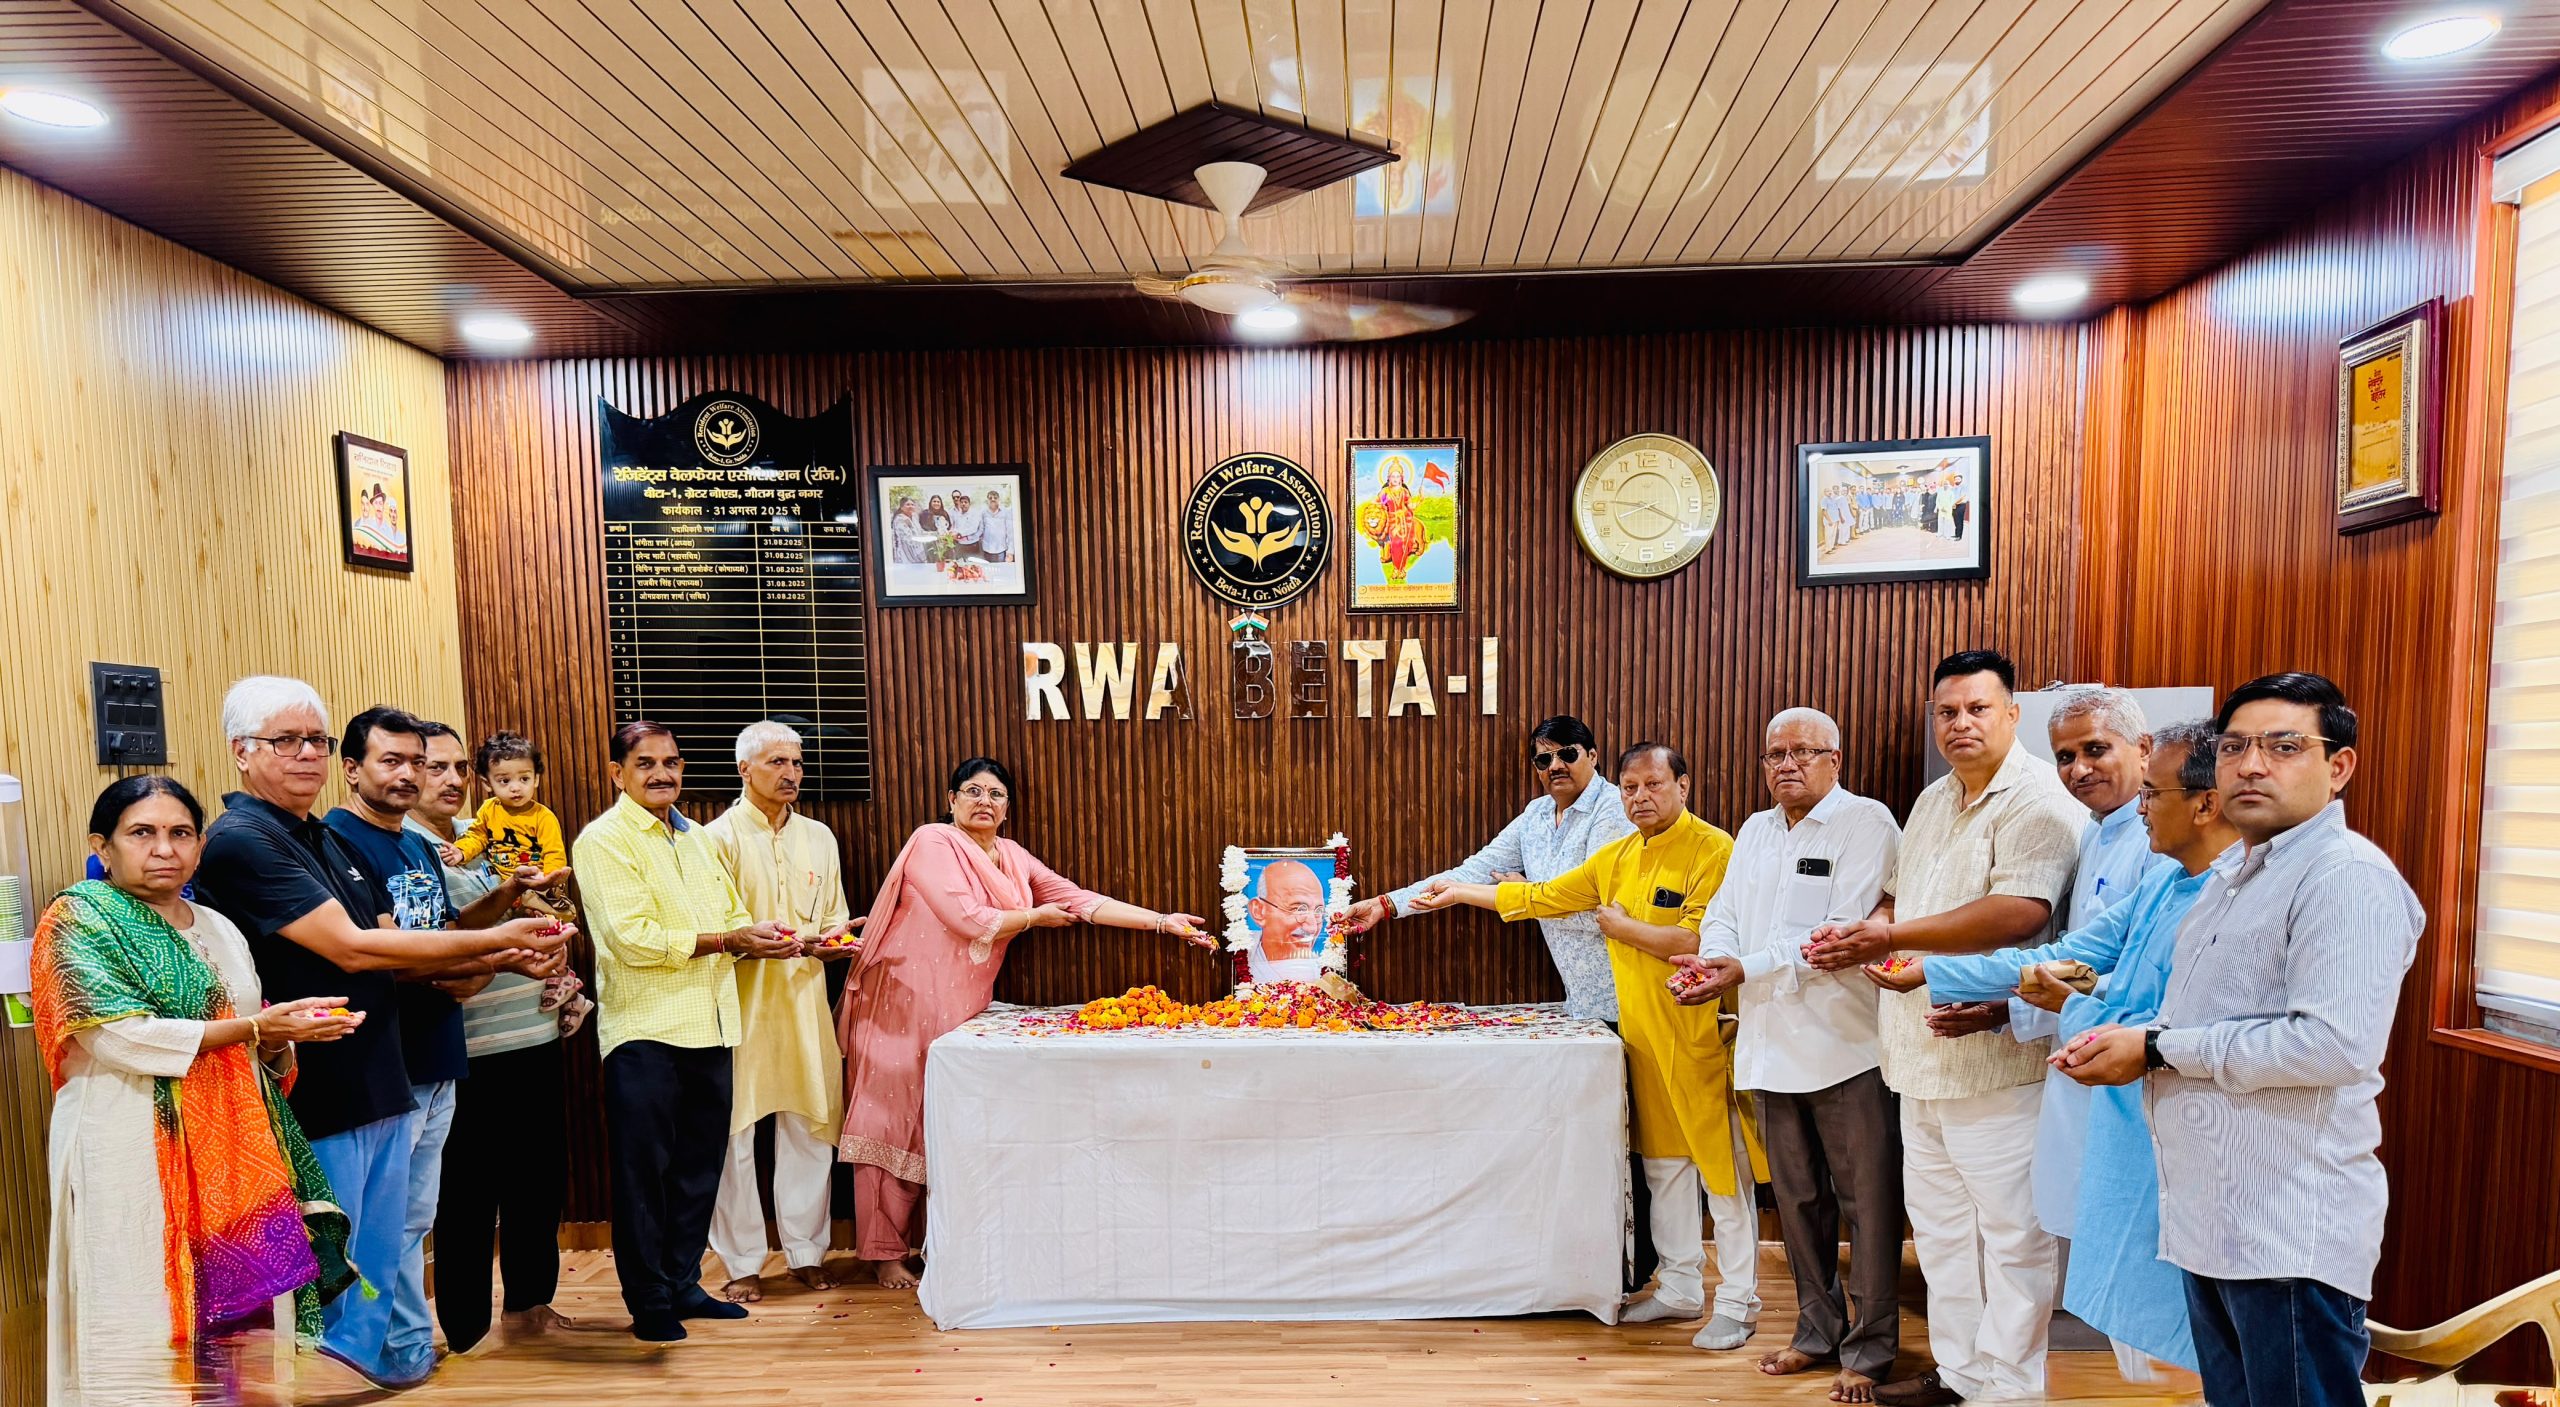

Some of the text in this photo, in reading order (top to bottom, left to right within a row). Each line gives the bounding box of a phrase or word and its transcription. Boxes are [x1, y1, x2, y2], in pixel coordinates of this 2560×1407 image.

[670, 467, 724, 480] वेलफेयर
[805, 465, 846, 485] (रजि.)
[685, 487, 707, 499] ग्रेटर
[709, 487, 742, 499] नोएडा,
[777, 490, 796, 501] बुद्ध
[798, 489, 823, 498] नगर
[1190, 461, 1320, 540] Resident Welfare Association
[661, 503, 800, 515] कार्यकाल 31 अगस्त 2025 से
[1688, 497, 1700, 513] 3
[1640, 547, 1653, 560] 6
[1664, 541, 1675, 552] 5
[1214, 576, 1302, 602] Beta-1, Gr. Noida
[1023, 642, 1194, 721] RWA
